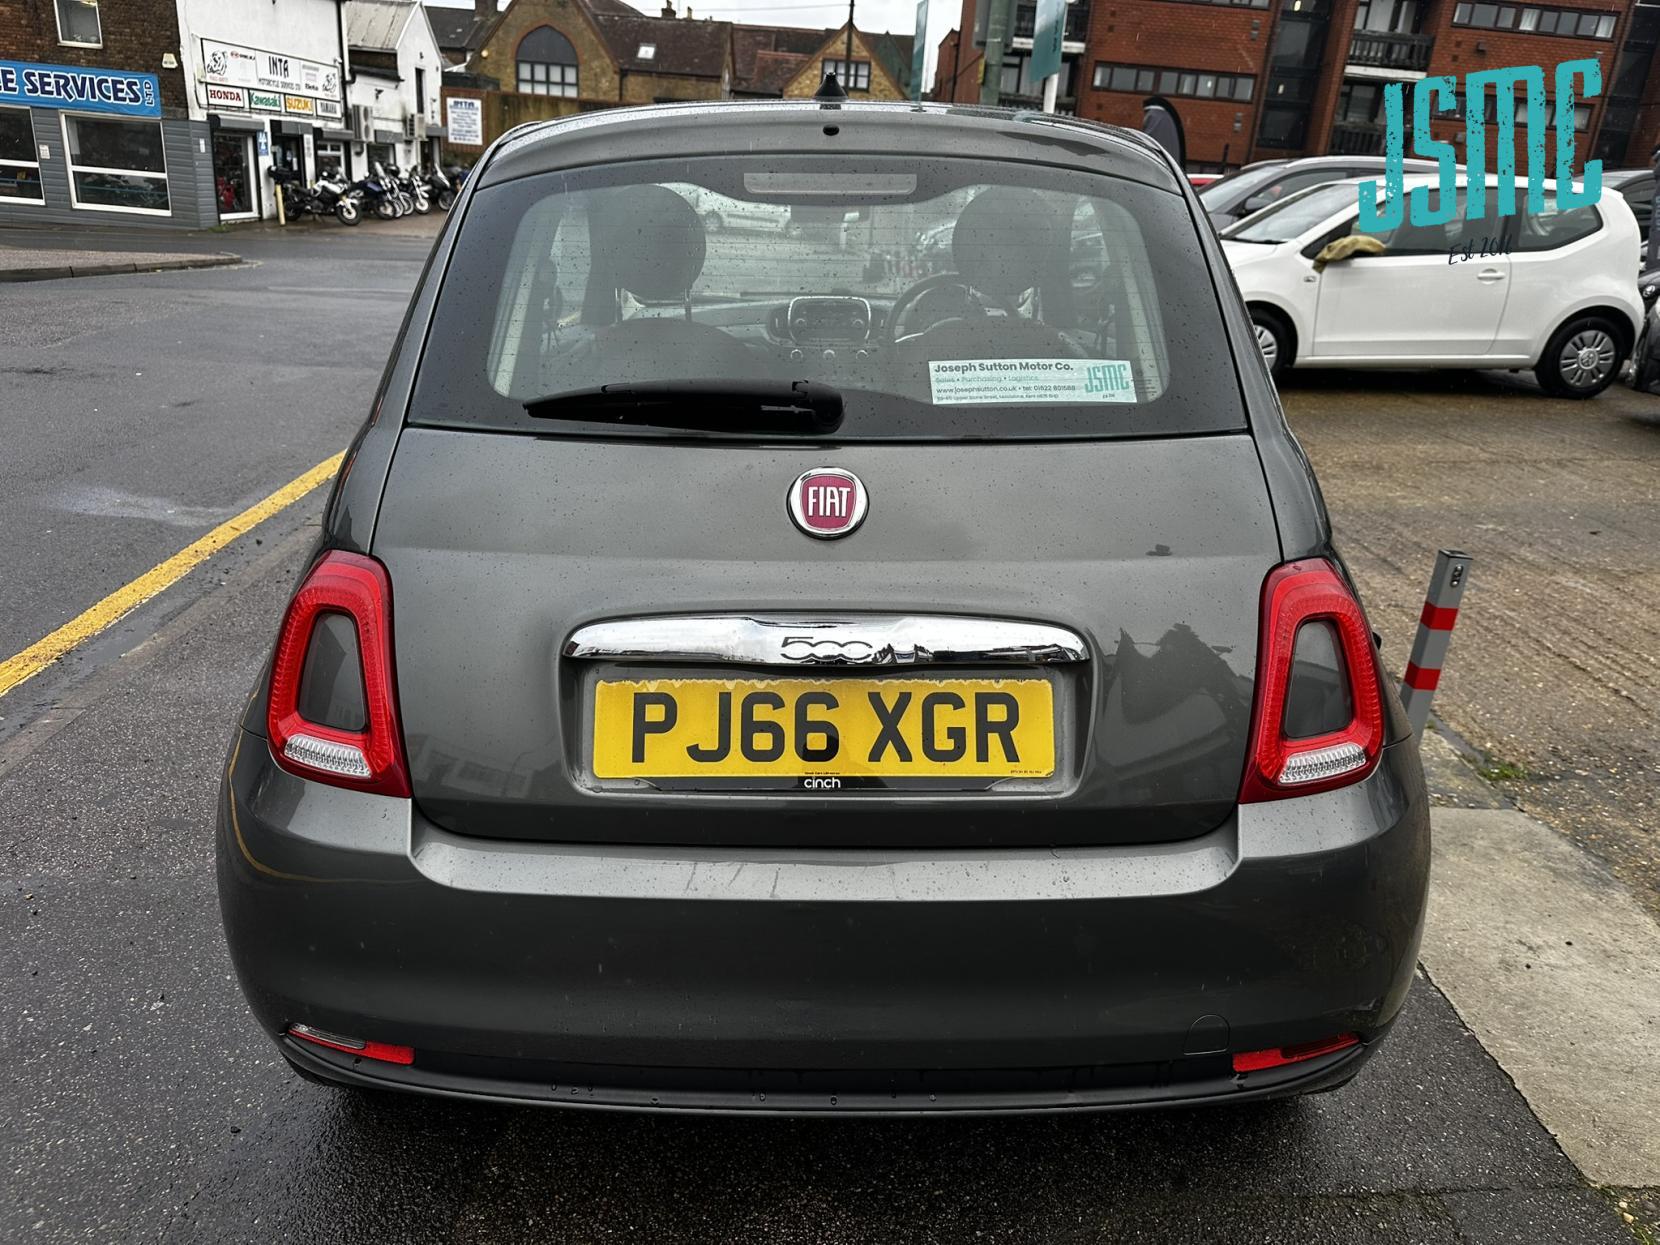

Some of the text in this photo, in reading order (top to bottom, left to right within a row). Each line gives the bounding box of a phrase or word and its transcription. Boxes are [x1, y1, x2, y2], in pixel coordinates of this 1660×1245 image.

[268, 55, 289, 78] INTA
[0, 67, 142, 104] E SERVICES
[143, 79, 154, 106] LTD
[209, 89, 242, 102] HONDA
[249, 91, 281, 107] Kawasaki
[286, 96, 313, 111] SUZUKI
[934, 362, 1074, 374] Joseph Sutton Motor Co.
[961, 375, 1002, 384] Purchasing
[1008, 375, 1039, 383] Logistics
[1084, 364, 1130, 393] JSMC
[808, 486, 851, 517] FIAT
[781, 636, 873, 661] 500
[631, 691, 1020, 763] PJ66 XGR
[804, 776, 841, 789] cinch
